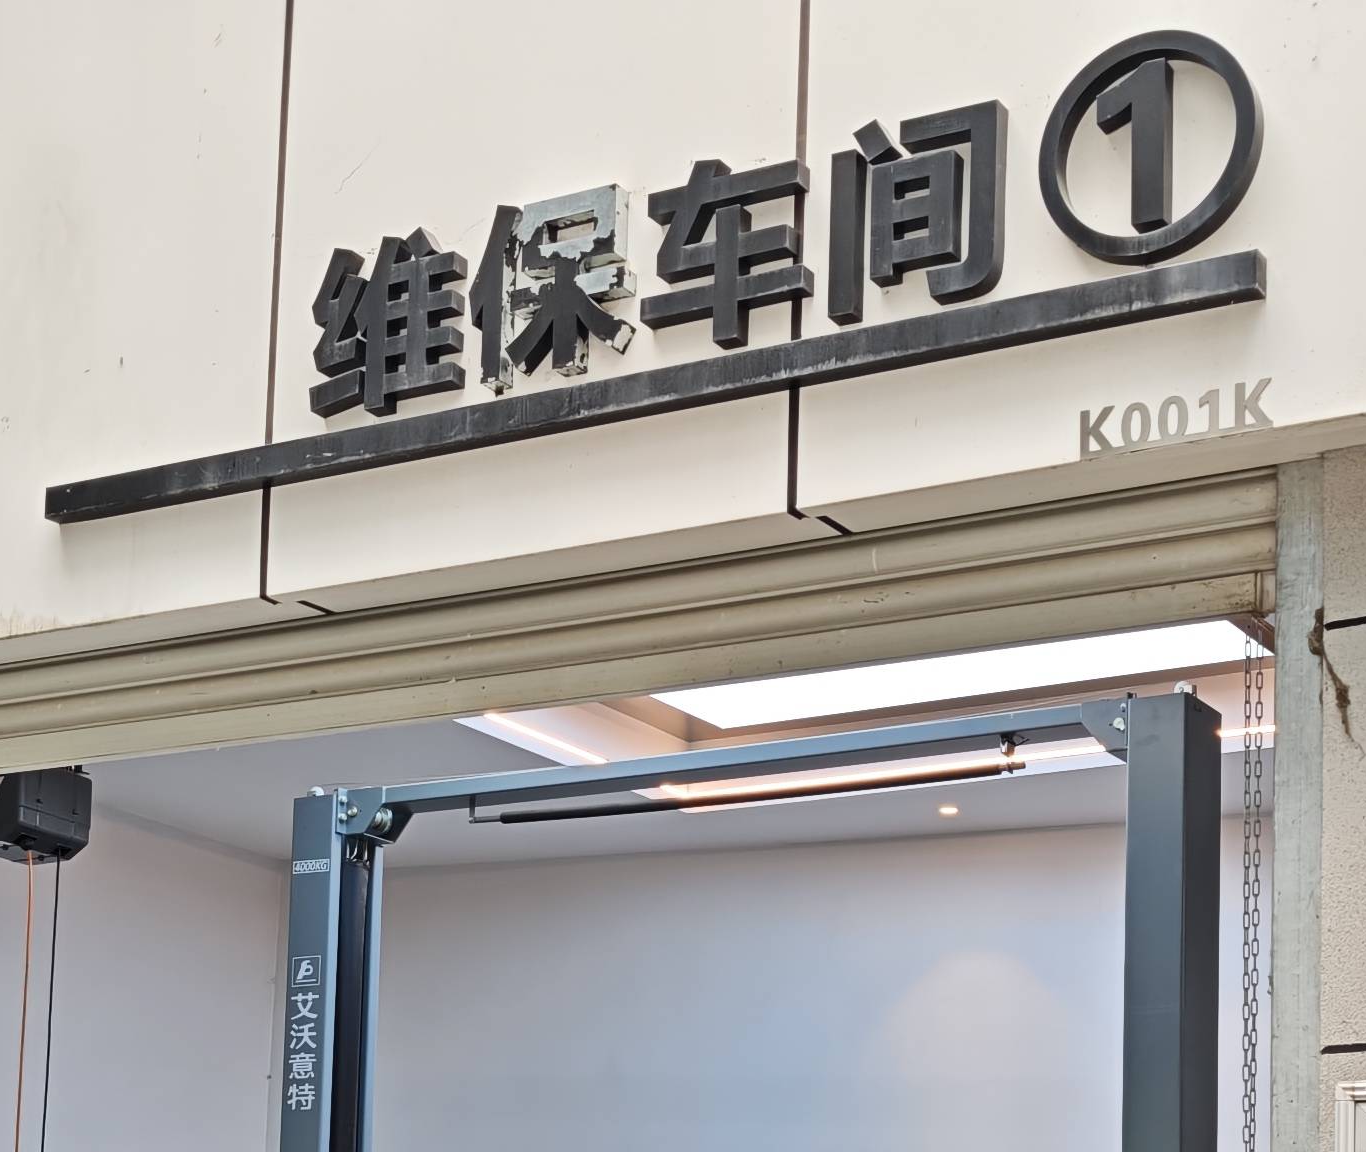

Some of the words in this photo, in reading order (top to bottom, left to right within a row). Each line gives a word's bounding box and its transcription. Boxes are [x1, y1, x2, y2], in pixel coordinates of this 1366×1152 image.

[1079, 377, 1274, 460] K001K
[294, 860, 328, 872] 4000KG
[287, 991, 318, 1112] 艾沃意特
